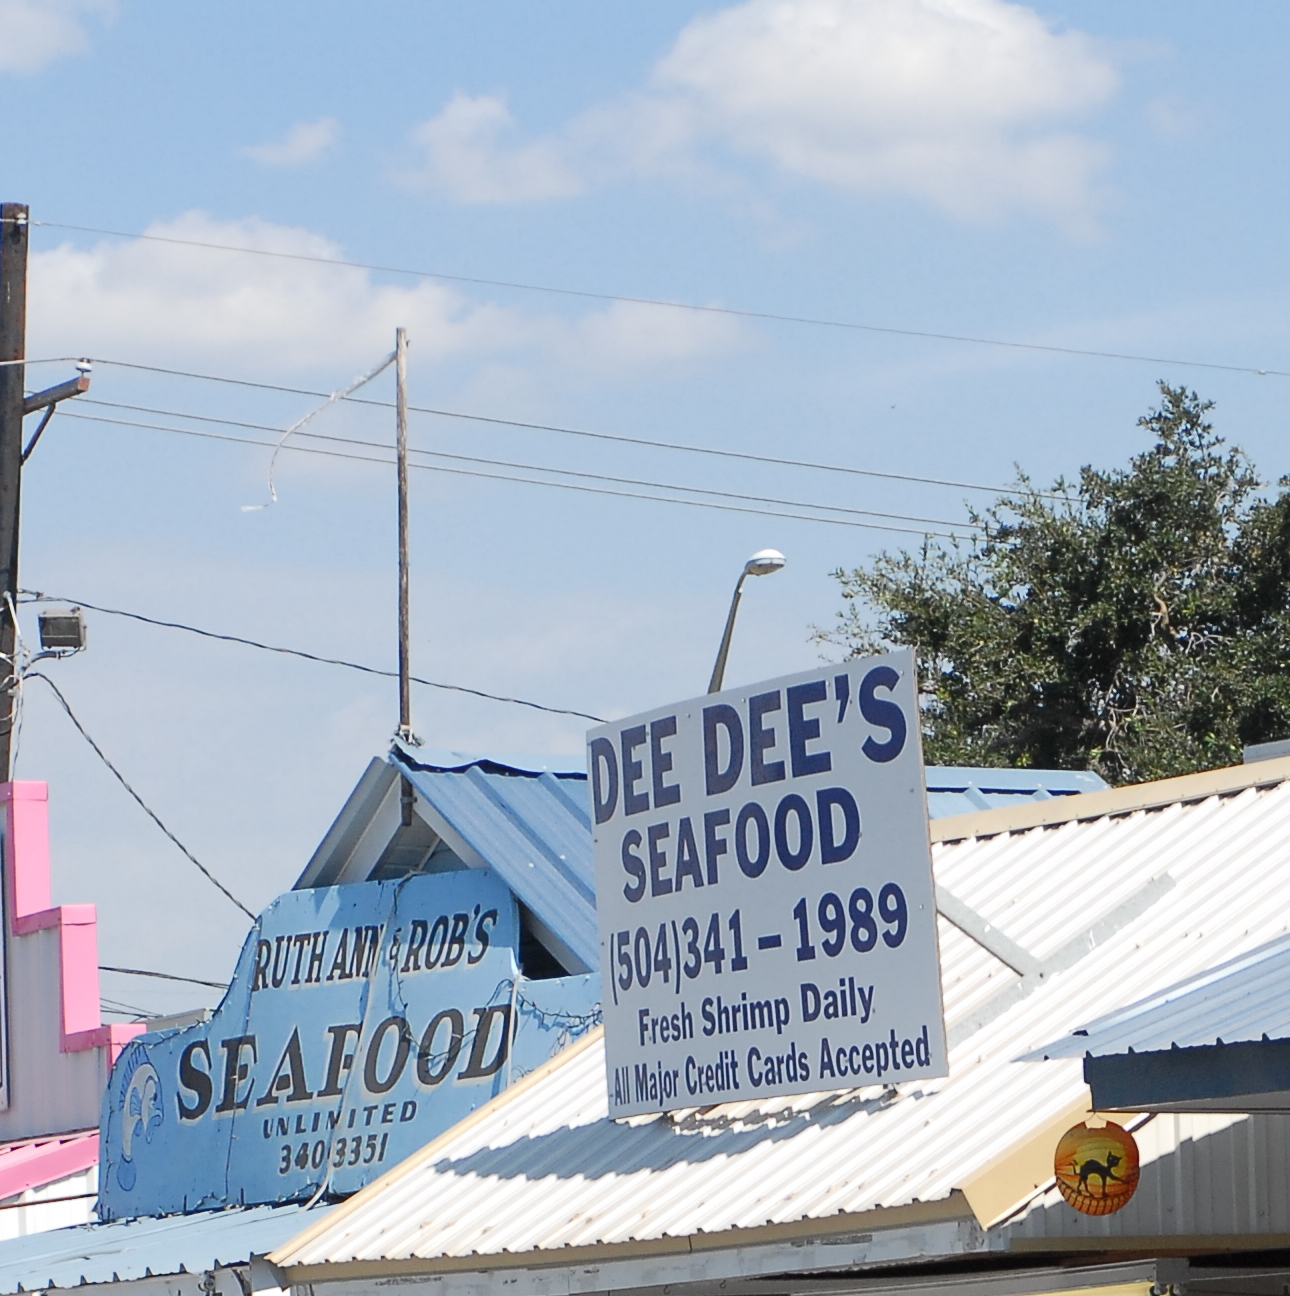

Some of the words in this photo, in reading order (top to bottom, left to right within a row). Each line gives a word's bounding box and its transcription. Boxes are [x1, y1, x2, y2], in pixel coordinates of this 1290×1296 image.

[591, 715, 681, 824] DEE
[703, 666, 907, 797] DEE'S
[621, 787, 861, 903] SEAFOOD
[400, 903, 498, 974] ROB'S
[639, 1002, 693, 1046] Fresh
[702, 992, 791, 1036] Shrimp
[801, 977, 874, 1023] Daily
[176, 1004, 518, 1122] SEAFOOD
[614, 1067, 630, 1107] All
[635, 1061, 679, 1107] Major
[685, 1055, 739, 1095] Credit
[747, 1042, 809, 1088] Cards
[819, 1026, 931, 1079] Accepted
[263, 1099, 417, 1139] UNLIMITED
